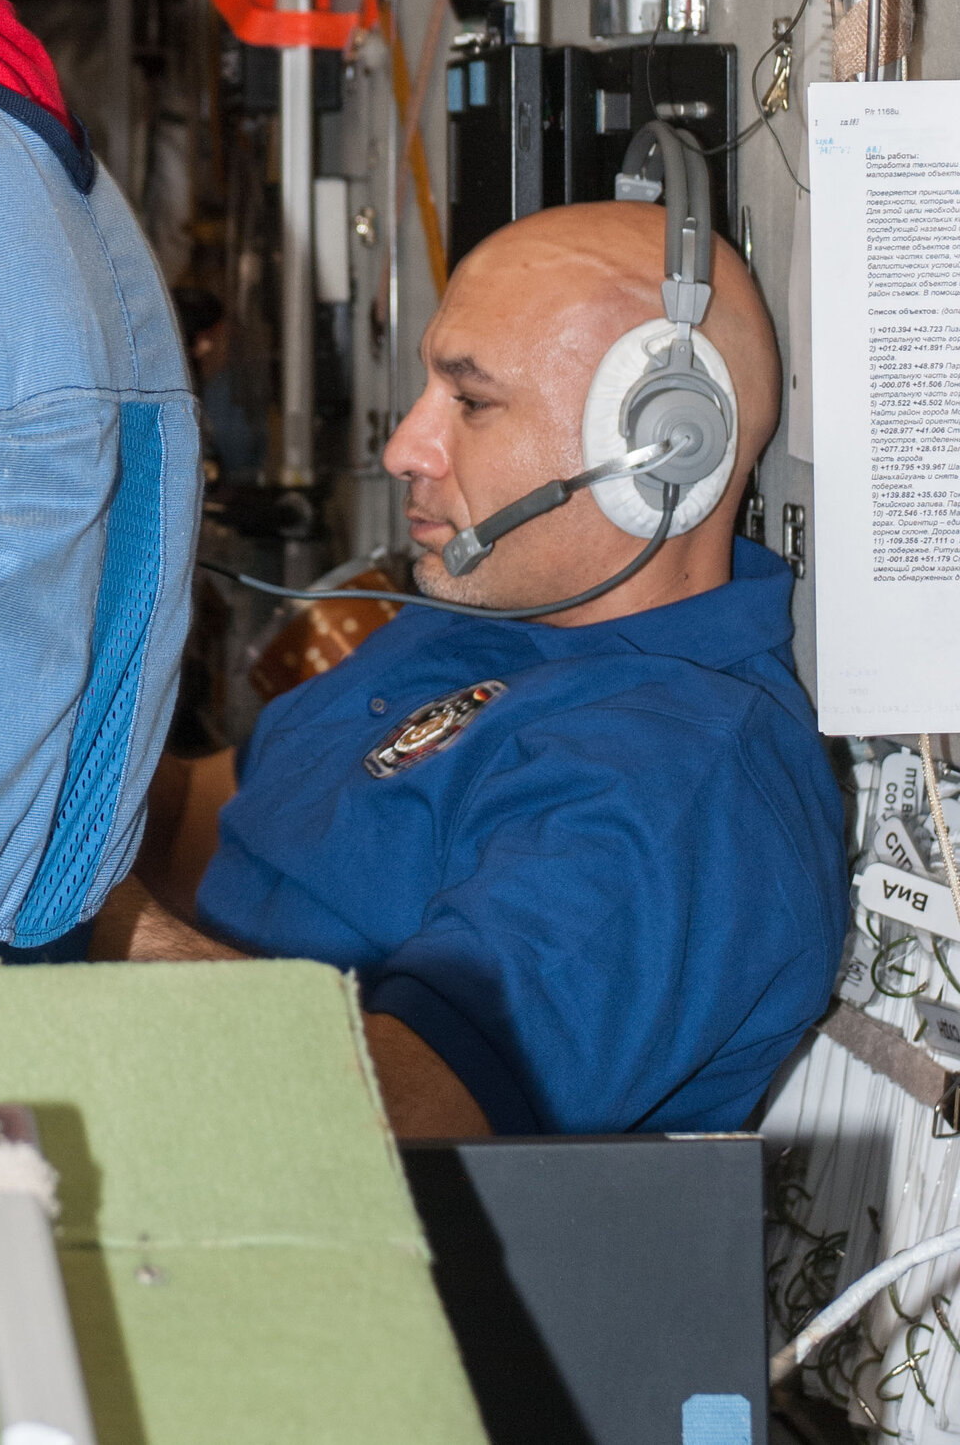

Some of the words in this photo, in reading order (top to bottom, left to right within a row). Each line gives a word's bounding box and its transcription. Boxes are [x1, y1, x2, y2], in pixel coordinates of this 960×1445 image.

[868, 290, 890, 298] район
[898, 574, 952, 582] обнаруженных
[904, 767, 918, 798] ПТО
[882, 879, 929, 912] ВиА
